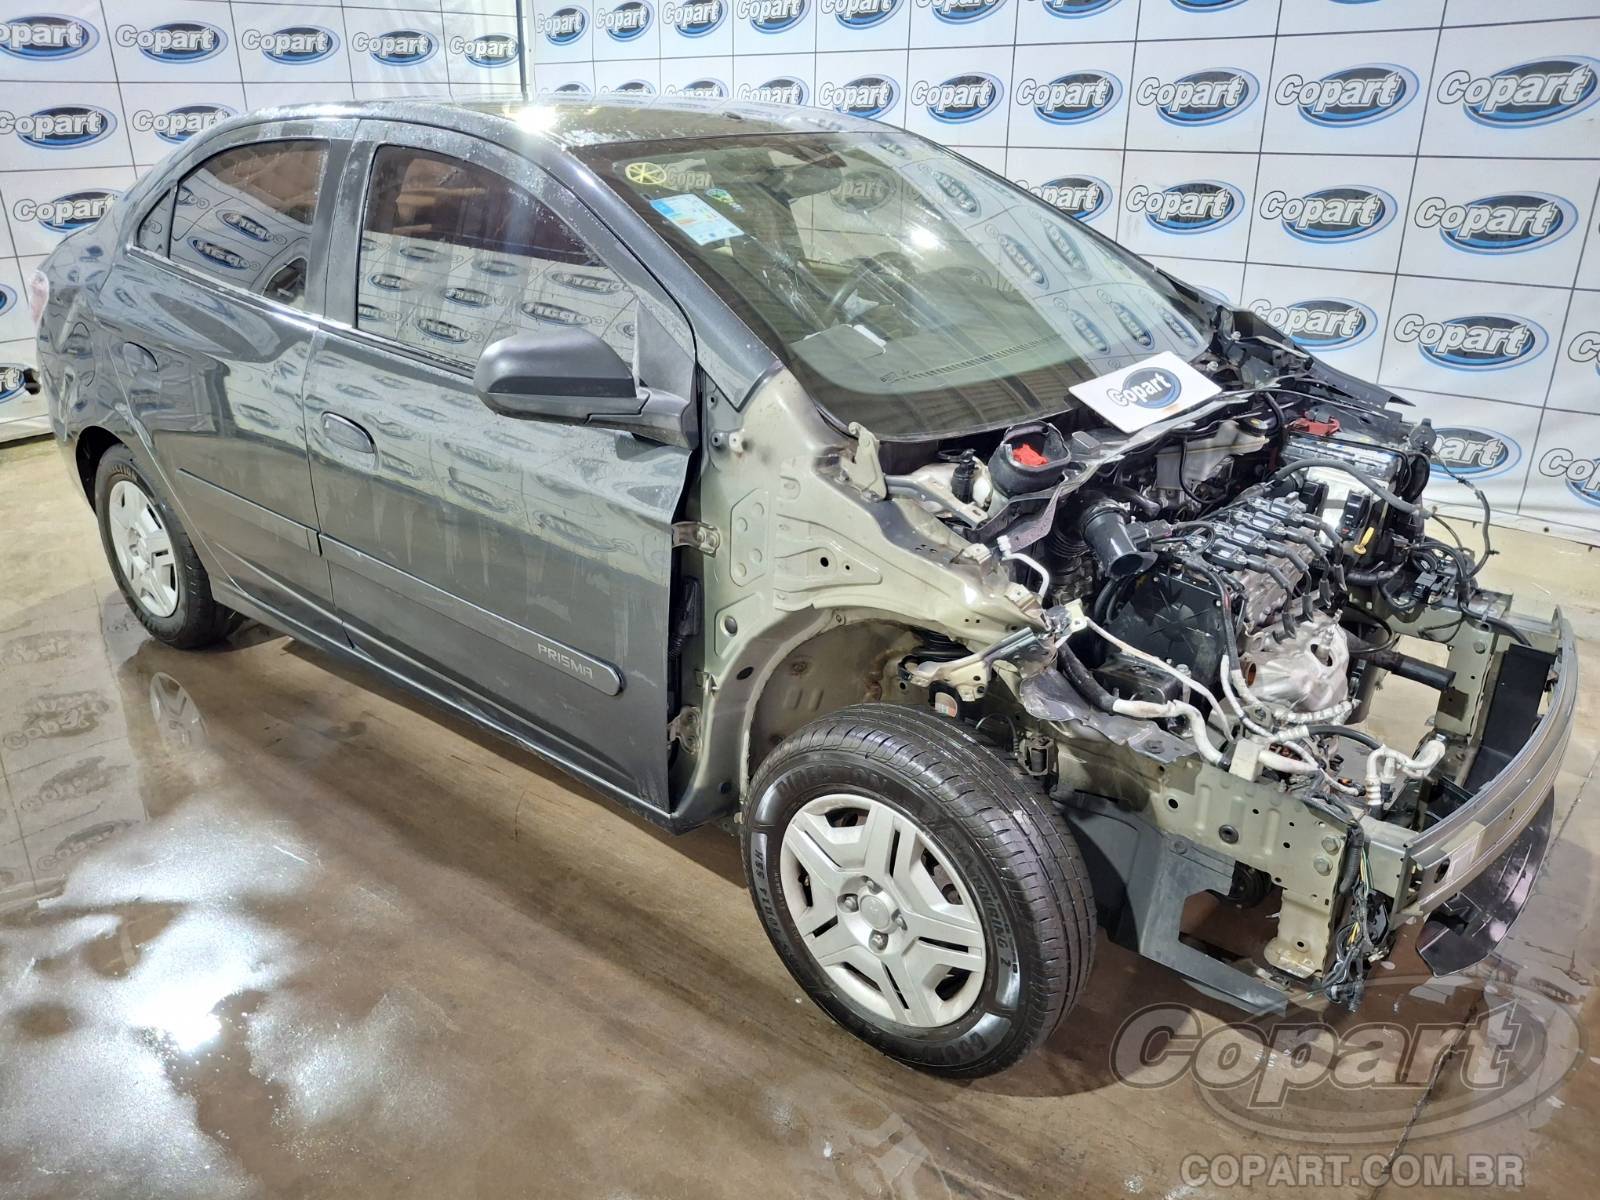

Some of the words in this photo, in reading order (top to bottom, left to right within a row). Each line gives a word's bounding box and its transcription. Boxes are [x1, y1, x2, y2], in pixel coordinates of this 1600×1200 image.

[536, 11, 583, 38] Copart
[595, 3, 648, 33] Copart
[662, 2, 721, 29] Copart
[736, 0, 802, 25] Copart
[0, 21, 83, 49] opart
[115, 24, 215, 54] Copart
[242, 29, 329, 54] Copart
[352, 32, 428, 58] Copart
[450, 36, 515, 58] Copart
[819, 80, 890, 115] Copart
[911, 79, 995, 113] Copart
[1016, 77, 1111, 113] Copart
[1136, 75, 1244, 115] Copart
[1275, 71, 1401, 114] Copart
[1437, 64, 1592, 115] Copart
[1015, 180, 1100, 211] part
[1126, 185, 1231, 221] Copart
[1260, 191, 1382, 230] Copart
[1415, 196, 1558, 239] Copart
[1249, 299, 1361, 338] Copart
[1394, 313, 1530, 356] Copart
[1106, 372, 1172, 407] Copart
[537, 643, 593, 679] PRISMA
